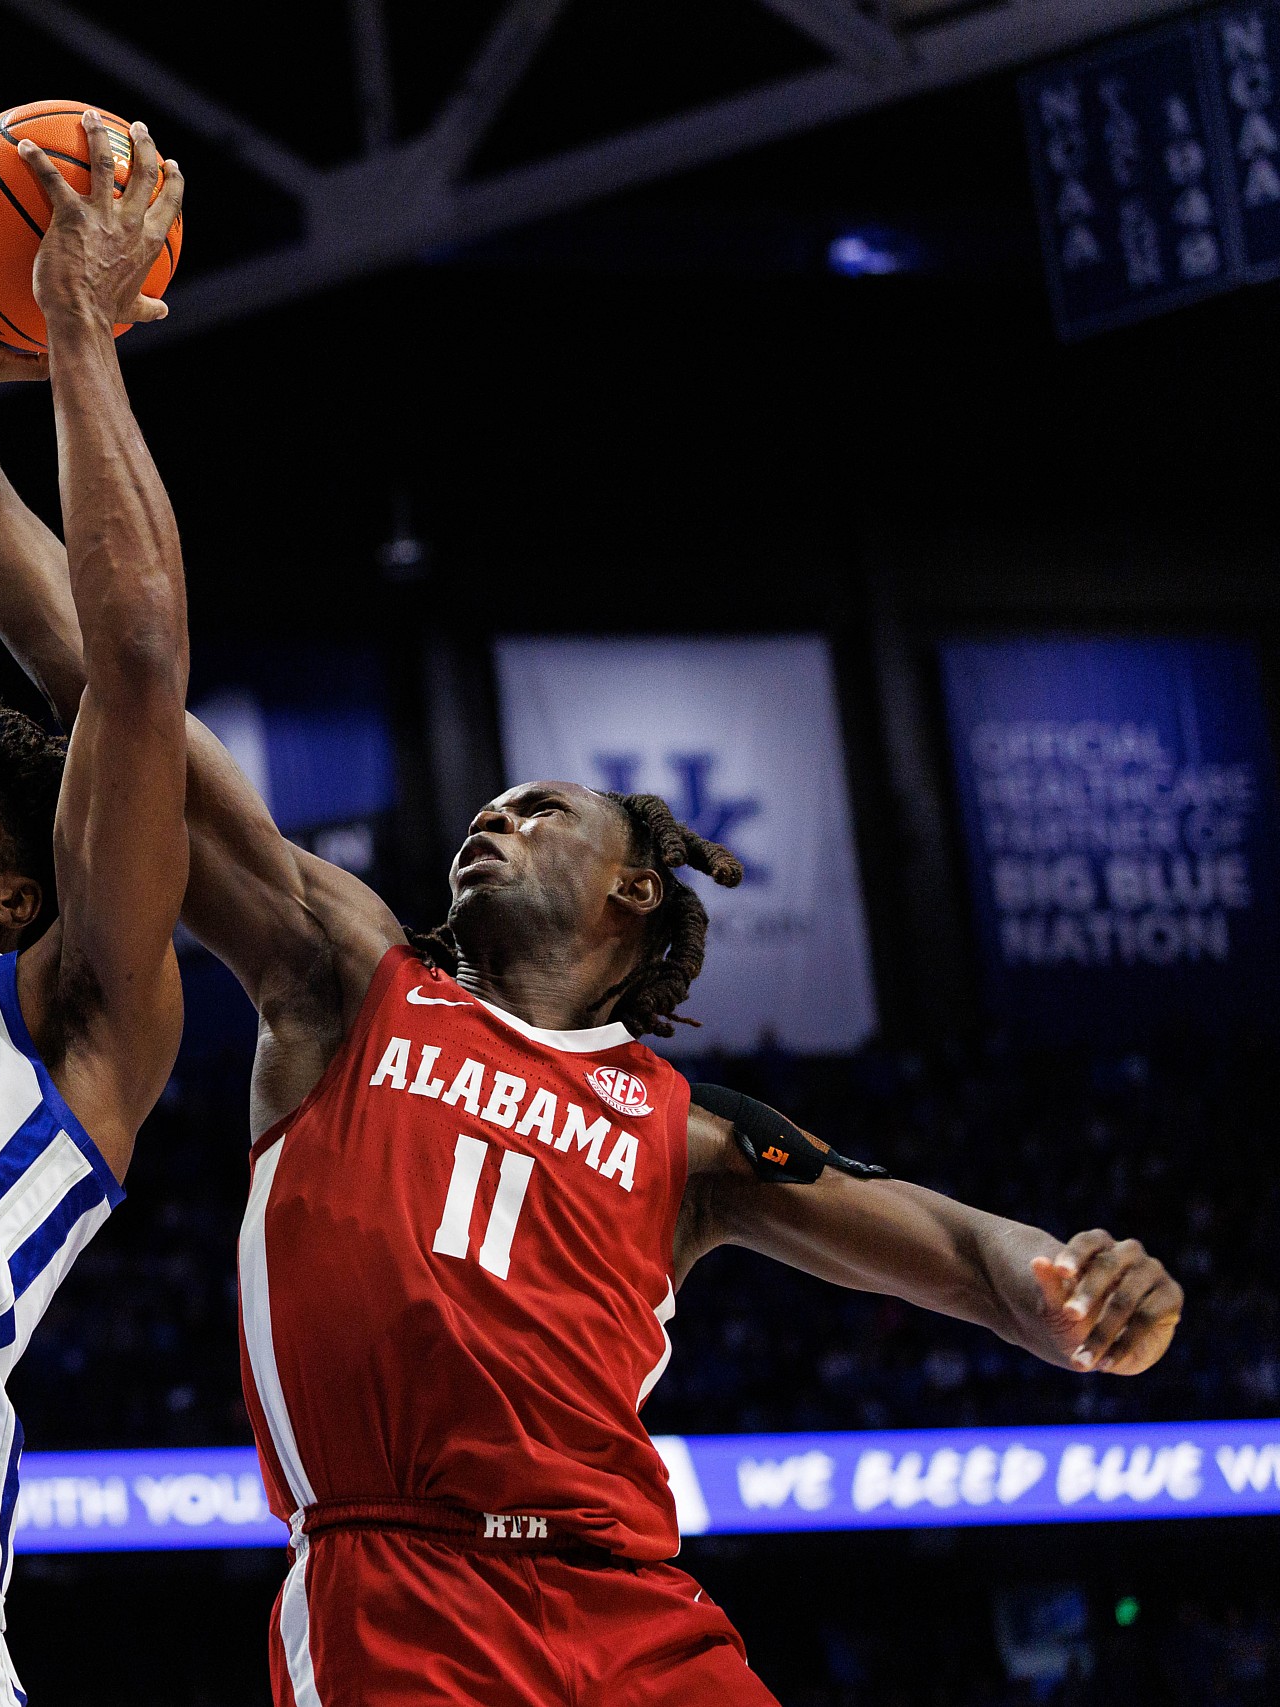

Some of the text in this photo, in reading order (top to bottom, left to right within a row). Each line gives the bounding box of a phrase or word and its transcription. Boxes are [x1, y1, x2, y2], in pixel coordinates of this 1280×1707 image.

[991, 853, 1253, 910] BIG BLUE
[999, 911, 1231, 966] NATION
[369, 1036, 641, 1192] ALABAMA
[599, 1070, 643, 1105] SEC
[432, 1133, 535, 1281] 11
[736, 1451, 836, 1511] WE
[851, 1443, 1047, 1513] BLEED
[1054, 1442, 1204, 1506] BLUE
[483, 1512, 548, 1539] RTR
